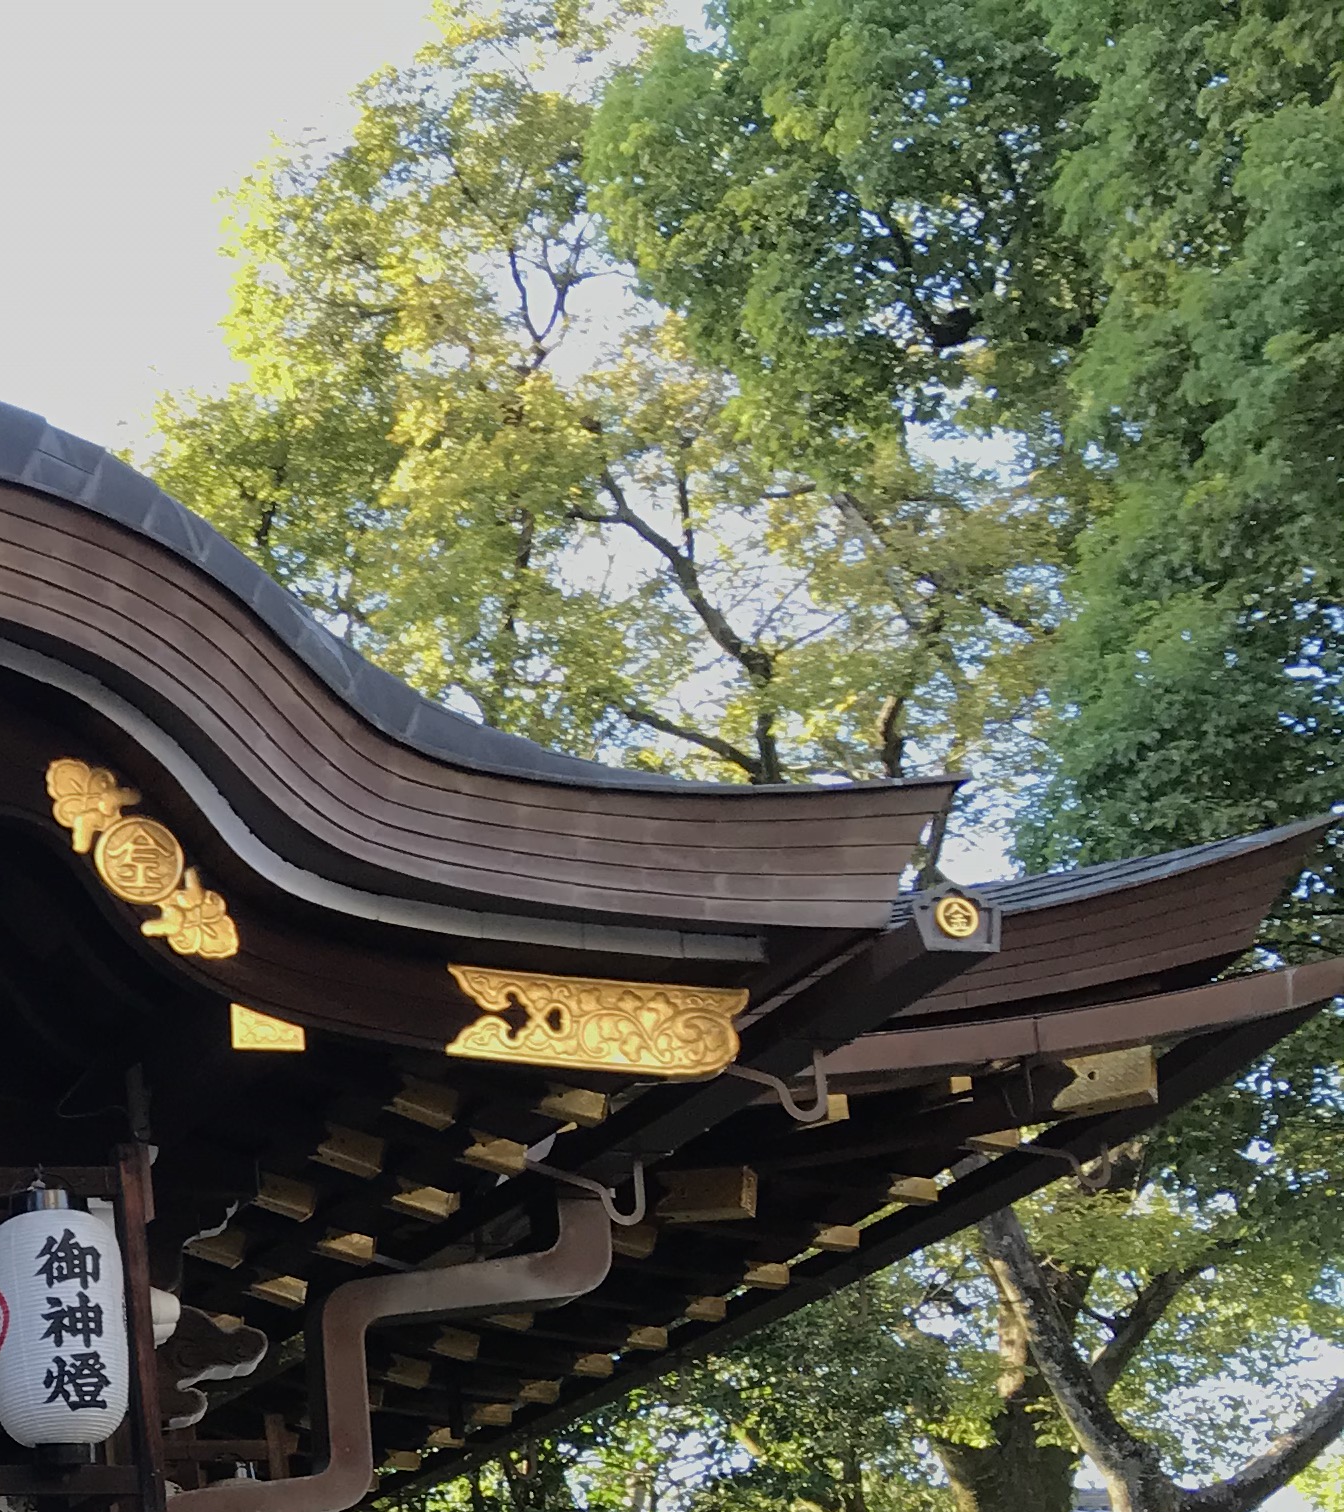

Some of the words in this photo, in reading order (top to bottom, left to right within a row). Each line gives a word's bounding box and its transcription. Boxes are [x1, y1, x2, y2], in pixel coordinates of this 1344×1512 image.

[108, 826, 174, 887] 金
[34, 1228, 111, 1412] 御神燈
